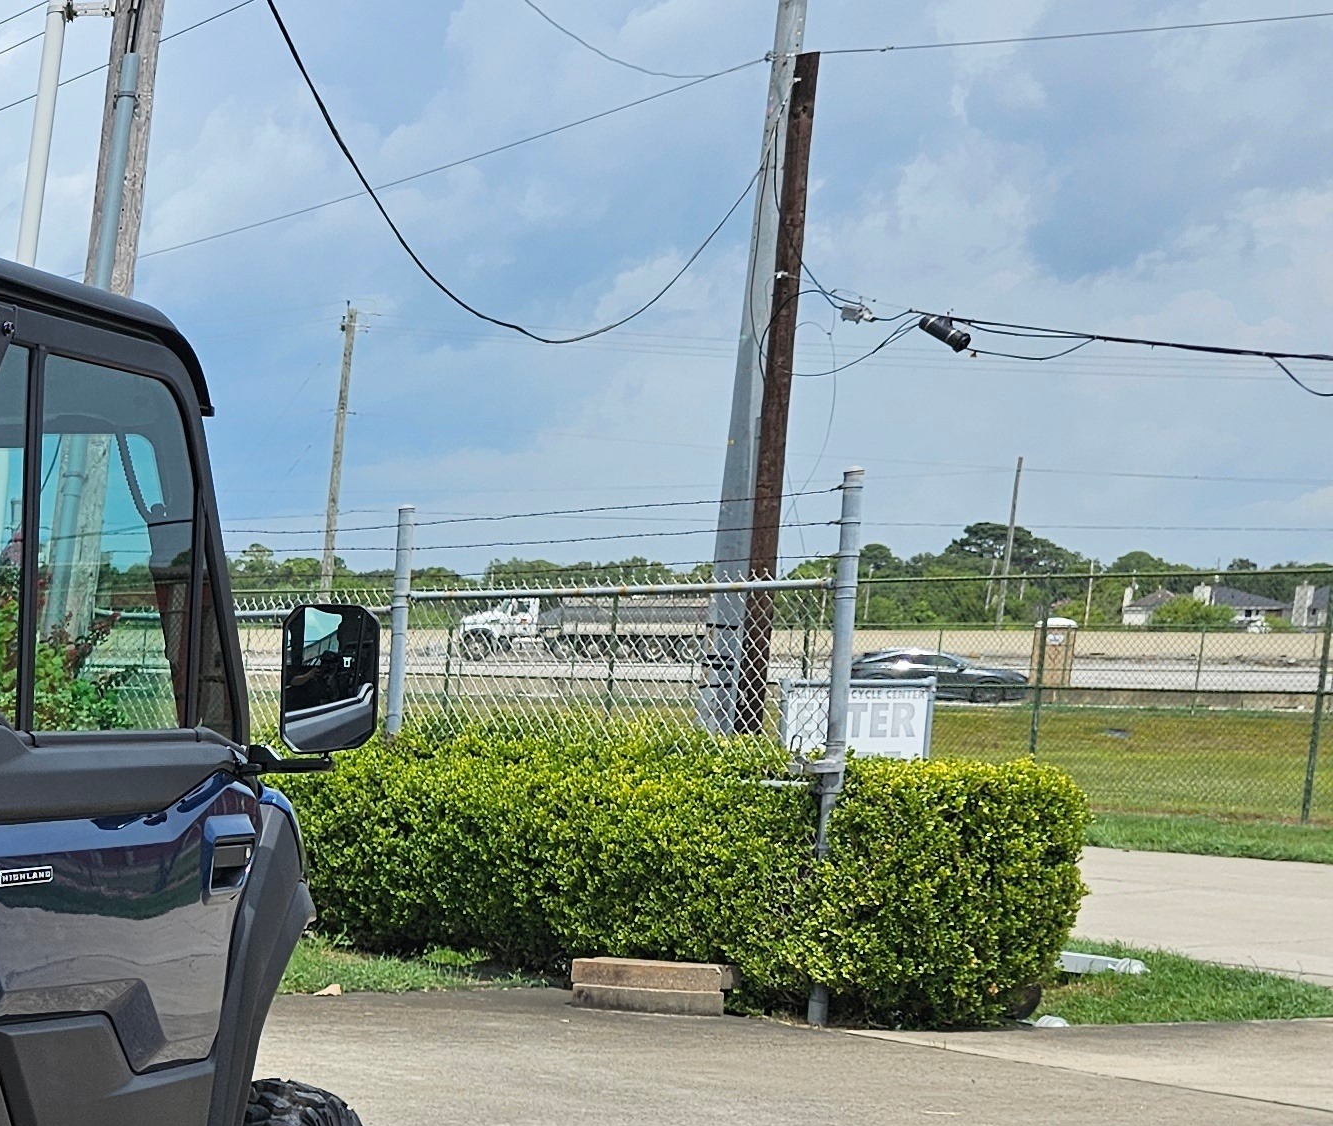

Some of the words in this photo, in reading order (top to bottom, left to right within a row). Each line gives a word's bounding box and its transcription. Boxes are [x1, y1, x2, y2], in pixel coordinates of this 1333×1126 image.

[851, 689, 882, 700] CYCLE
[886, 689, 926, 700] CENTER
[2, 871, 51, 882] HIGHLAND
